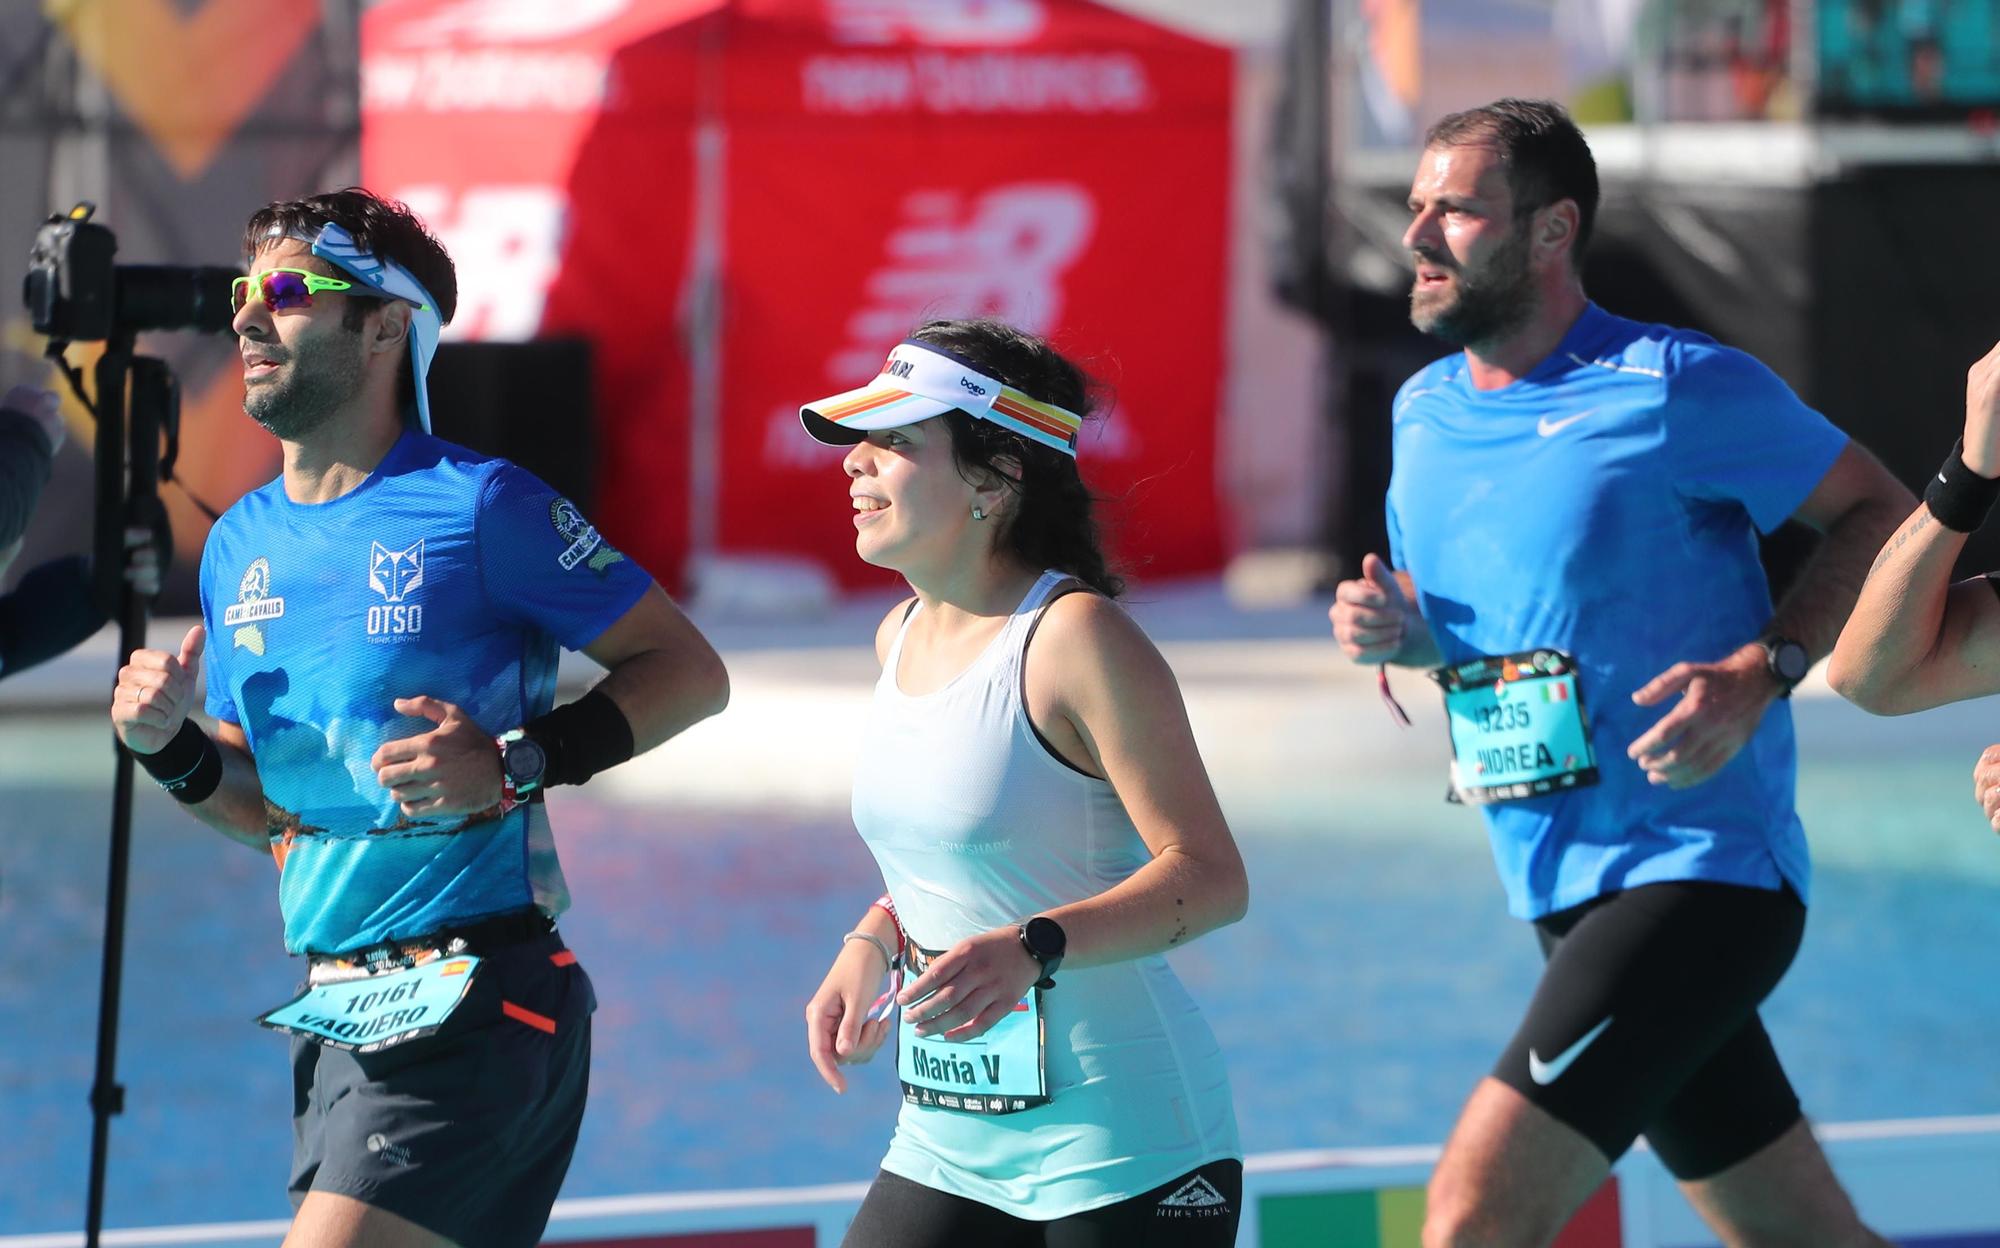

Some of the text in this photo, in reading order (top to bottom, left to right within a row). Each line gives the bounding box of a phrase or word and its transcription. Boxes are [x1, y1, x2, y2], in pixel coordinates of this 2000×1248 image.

[367, 605, 422, 634] OTSO
[344, 978, 422, 1015] 10161
[296, 1006, 429, 1039] VAQUERO
[912, 1046, 1000, 1085] Maria V
[1156, 1206, 1231, 1218] NIKE TRAIL
